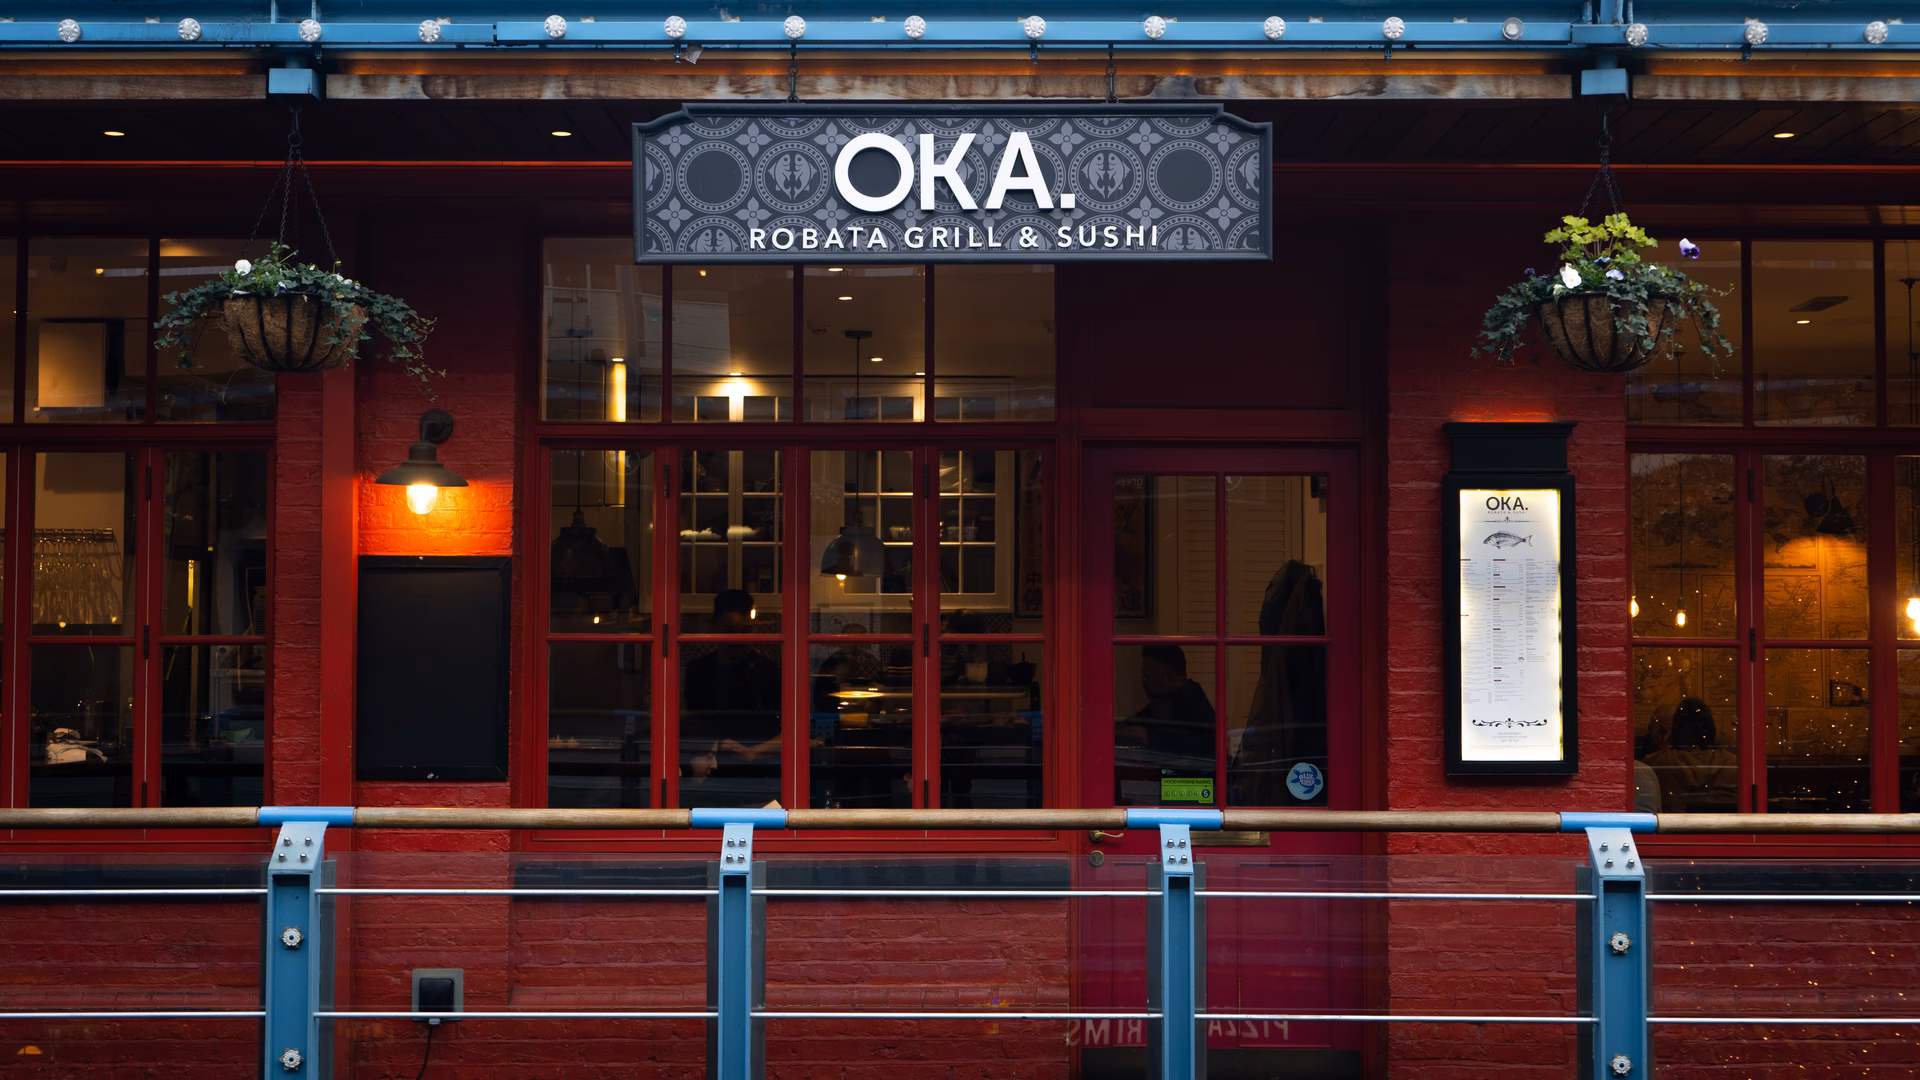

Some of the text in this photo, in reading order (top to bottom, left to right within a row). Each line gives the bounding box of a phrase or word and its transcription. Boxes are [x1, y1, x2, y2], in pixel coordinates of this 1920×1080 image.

[834, 131, 1076, 212] OKA.
[749, 224, 1159, 250] ROBATA GRILL & SUSHI
[1485, 496, 1529, 511] OKA.
